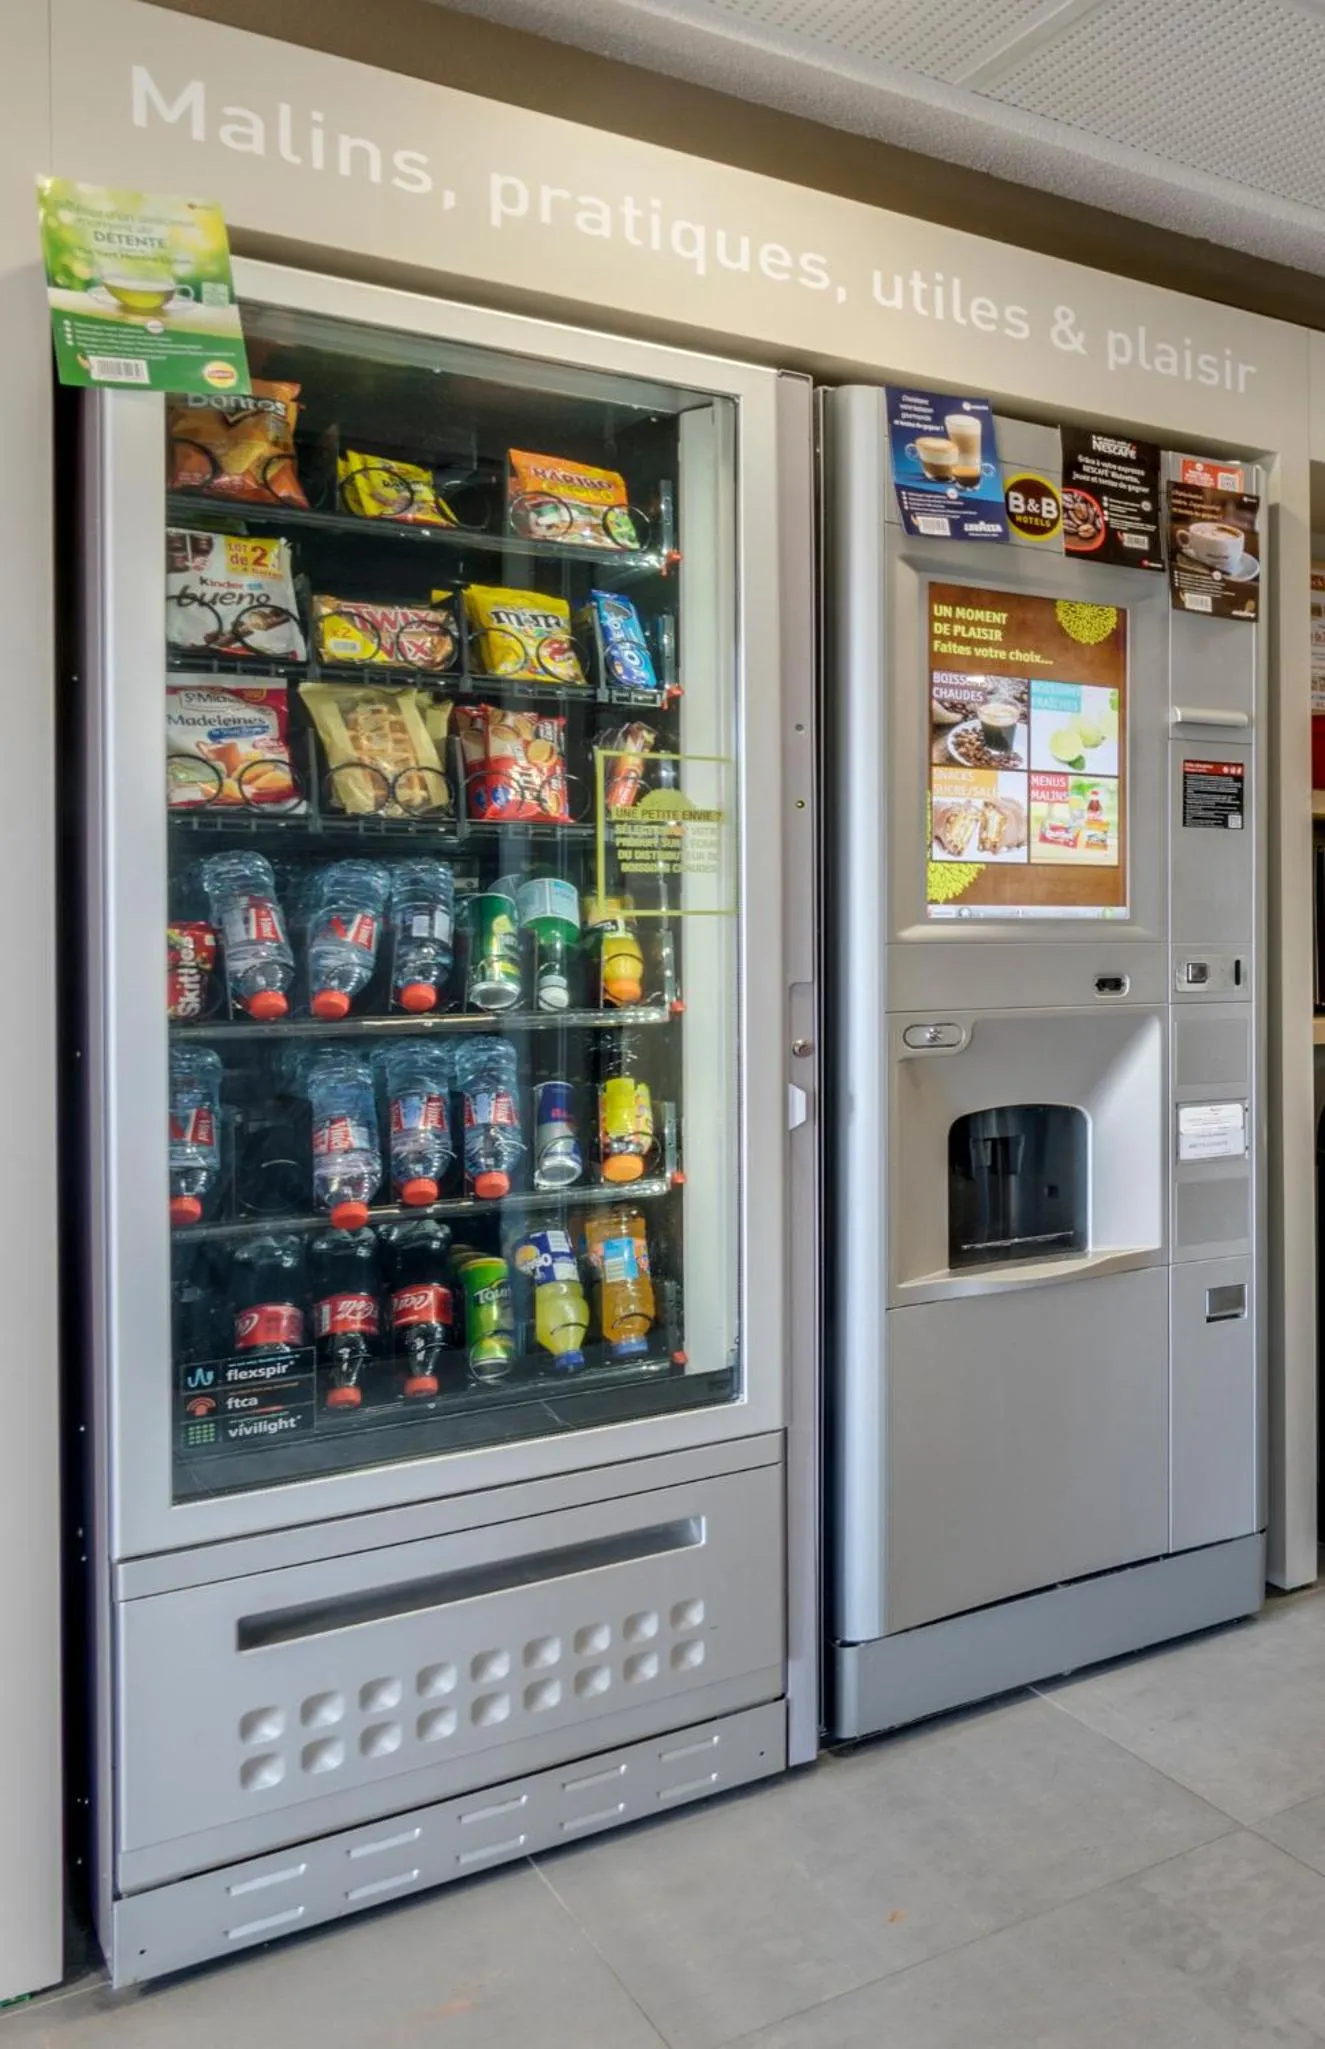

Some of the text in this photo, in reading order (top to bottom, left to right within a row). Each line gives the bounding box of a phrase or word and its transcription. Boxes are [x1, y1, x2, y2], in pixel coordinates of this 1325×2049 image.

[132, 64, 1257, 393] Malins, pratiques, utiles & plaisir
[531, 465, 614, 490] HARIBO
[1009, 490, 1058, 520] B&B
[1015, 514, 1051, 528] HOTELS
[250, 545, 269, 568] 2
[175, 584, 271, 608] bueno
[933, 604, 1009, 625] UN MOMENT
[933, 621, 1003, 642] DE PLAISIR
[933, 640, 972, 656] Faites
[974, 646, 1007, 660] votre
[932, 687, 985, 702] CHAUDES
[1030, 775, 1066, 788] MENUS
[1030, 789, 1070, 801] MALINS
[226, 1396, 259, 1410] ftca
